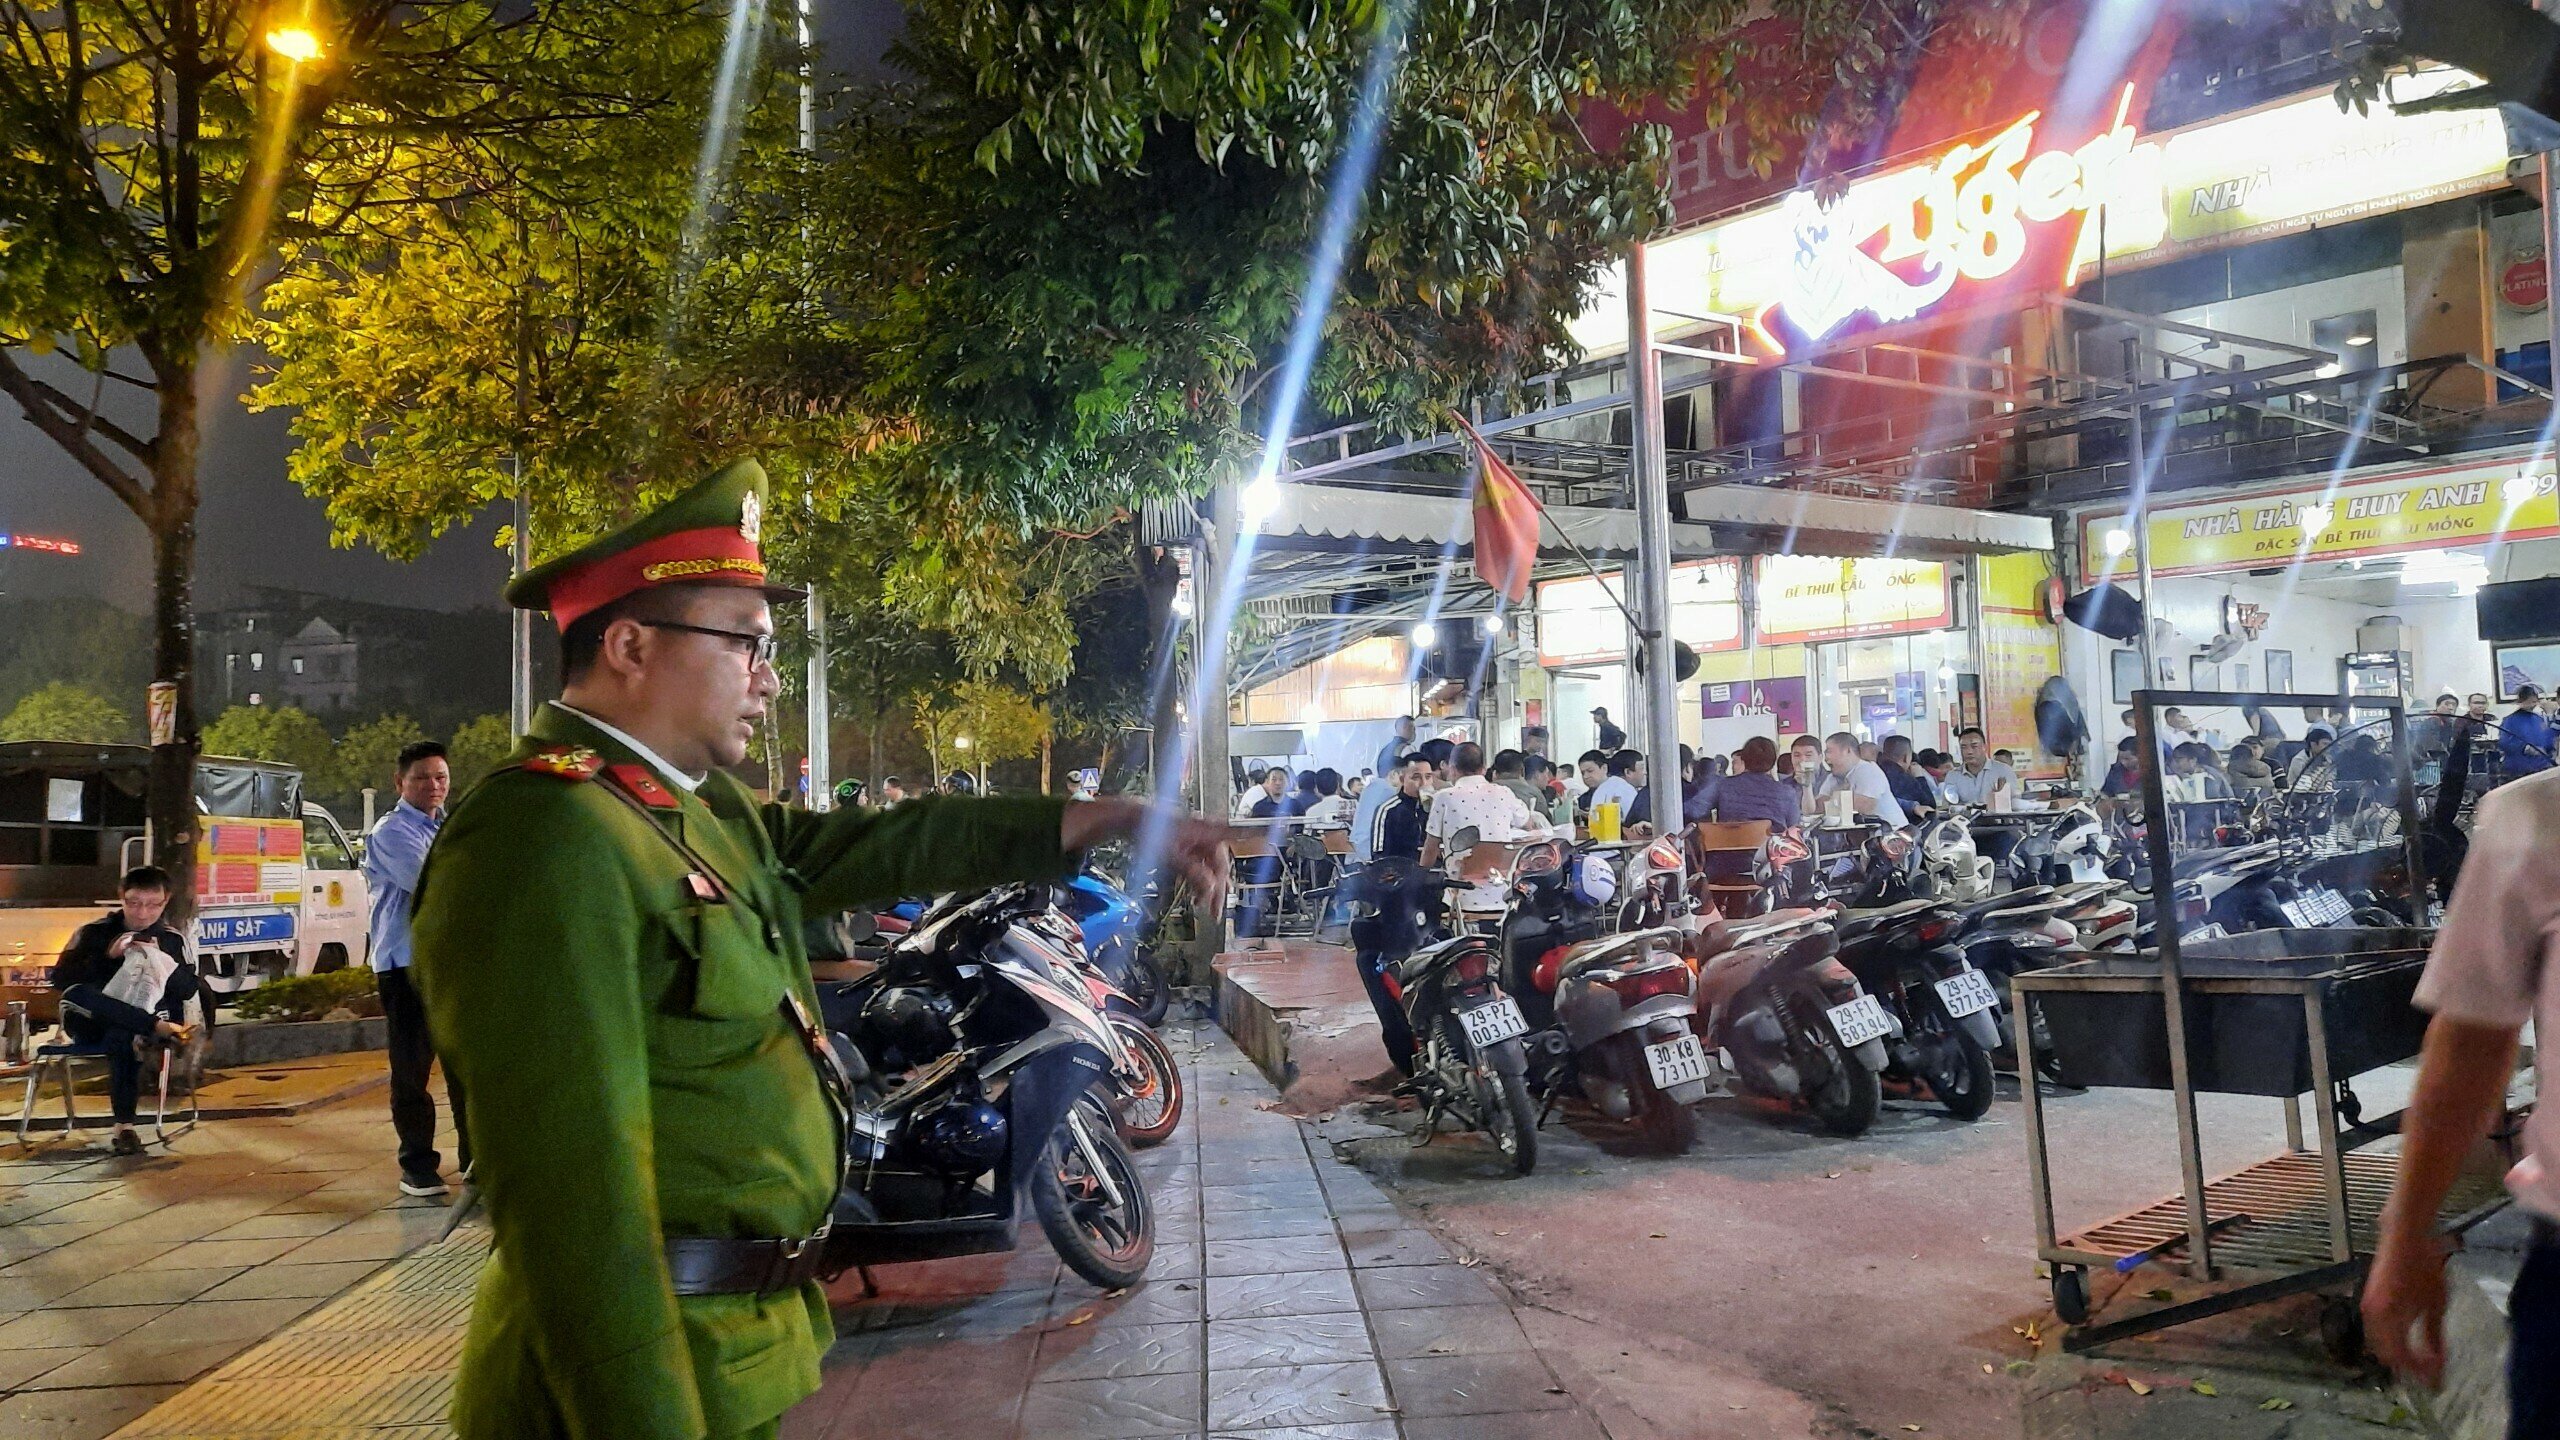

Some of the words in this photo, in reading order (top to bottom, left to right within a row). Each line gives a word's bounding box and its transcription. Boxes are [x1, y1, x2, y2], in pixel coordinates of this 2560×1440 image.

[2184, 507, 2243, 539] NHÀ
[2347, 490, 2412, 520] HUY
[2417, 481, 2489, 512] ANH
[1806, 582, 1835, 596] THUI
[1944, 973, 1981, 997] 29-L5
[1836, 1000, 1874, 1025] 29-F1
[1948, 988, 1994, 1015] 577.69
[1472, 1016, 1523, 1045] 003.11
[1841, 1017, 1886, 1044] 583.94
[1660, 1060, 1699, 1085] 7311
